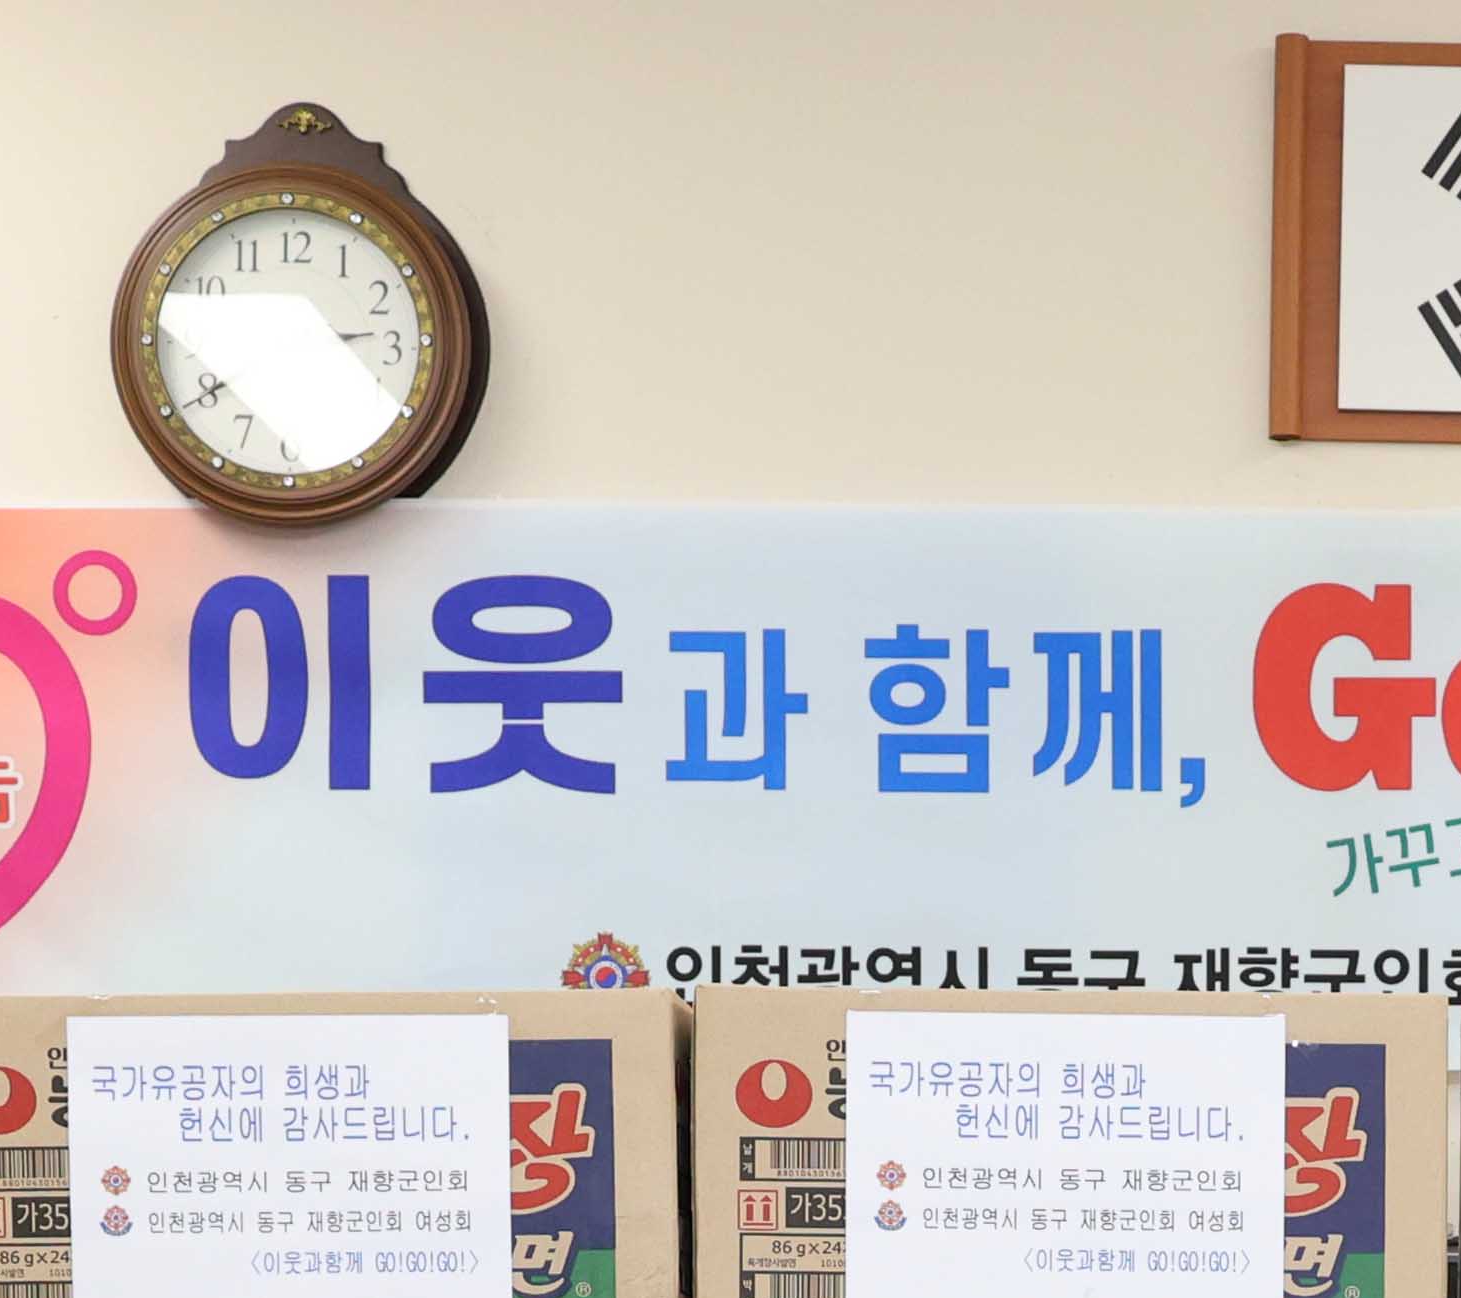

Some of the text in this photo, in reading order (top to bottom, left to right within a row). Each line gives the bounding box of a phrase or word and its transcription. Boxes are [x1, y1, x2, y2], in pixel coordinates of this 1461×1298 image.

[234, 240, 259, 273] 11
[280, 231, 313, 263] 12
[337, 244, 349, 279] 1
[369, 280, 389, 315] 2
[383, 331, 403, 366] 3
[233, 414, 254, 449] 7
[189, 574, 807, 794] 이웃과
[865, 623, 1207, 810] 함께,
[93, 1065, 369, 1100] 국가유공자의 희생과
[870, 1062, 1145, 1099] 국가유공자의 희생과
[180, 1107, 468, 1142] 헌신에 감사드립니다.
[957, 1104, 1243, 1141] 헌신에 감사드립니다.
[148, 1171, 467, 1193] 인천광역시 동구 재향군인회
[923, 1168, 1240, 1191] 인천광역시 동구 재향군인회
[149, 1211, 470, 1233] 인천광역시 동구 재향군인회 여성회
[923, 1208, 1243, 1232] 인천광역시 동구 재향군인회 여성회
